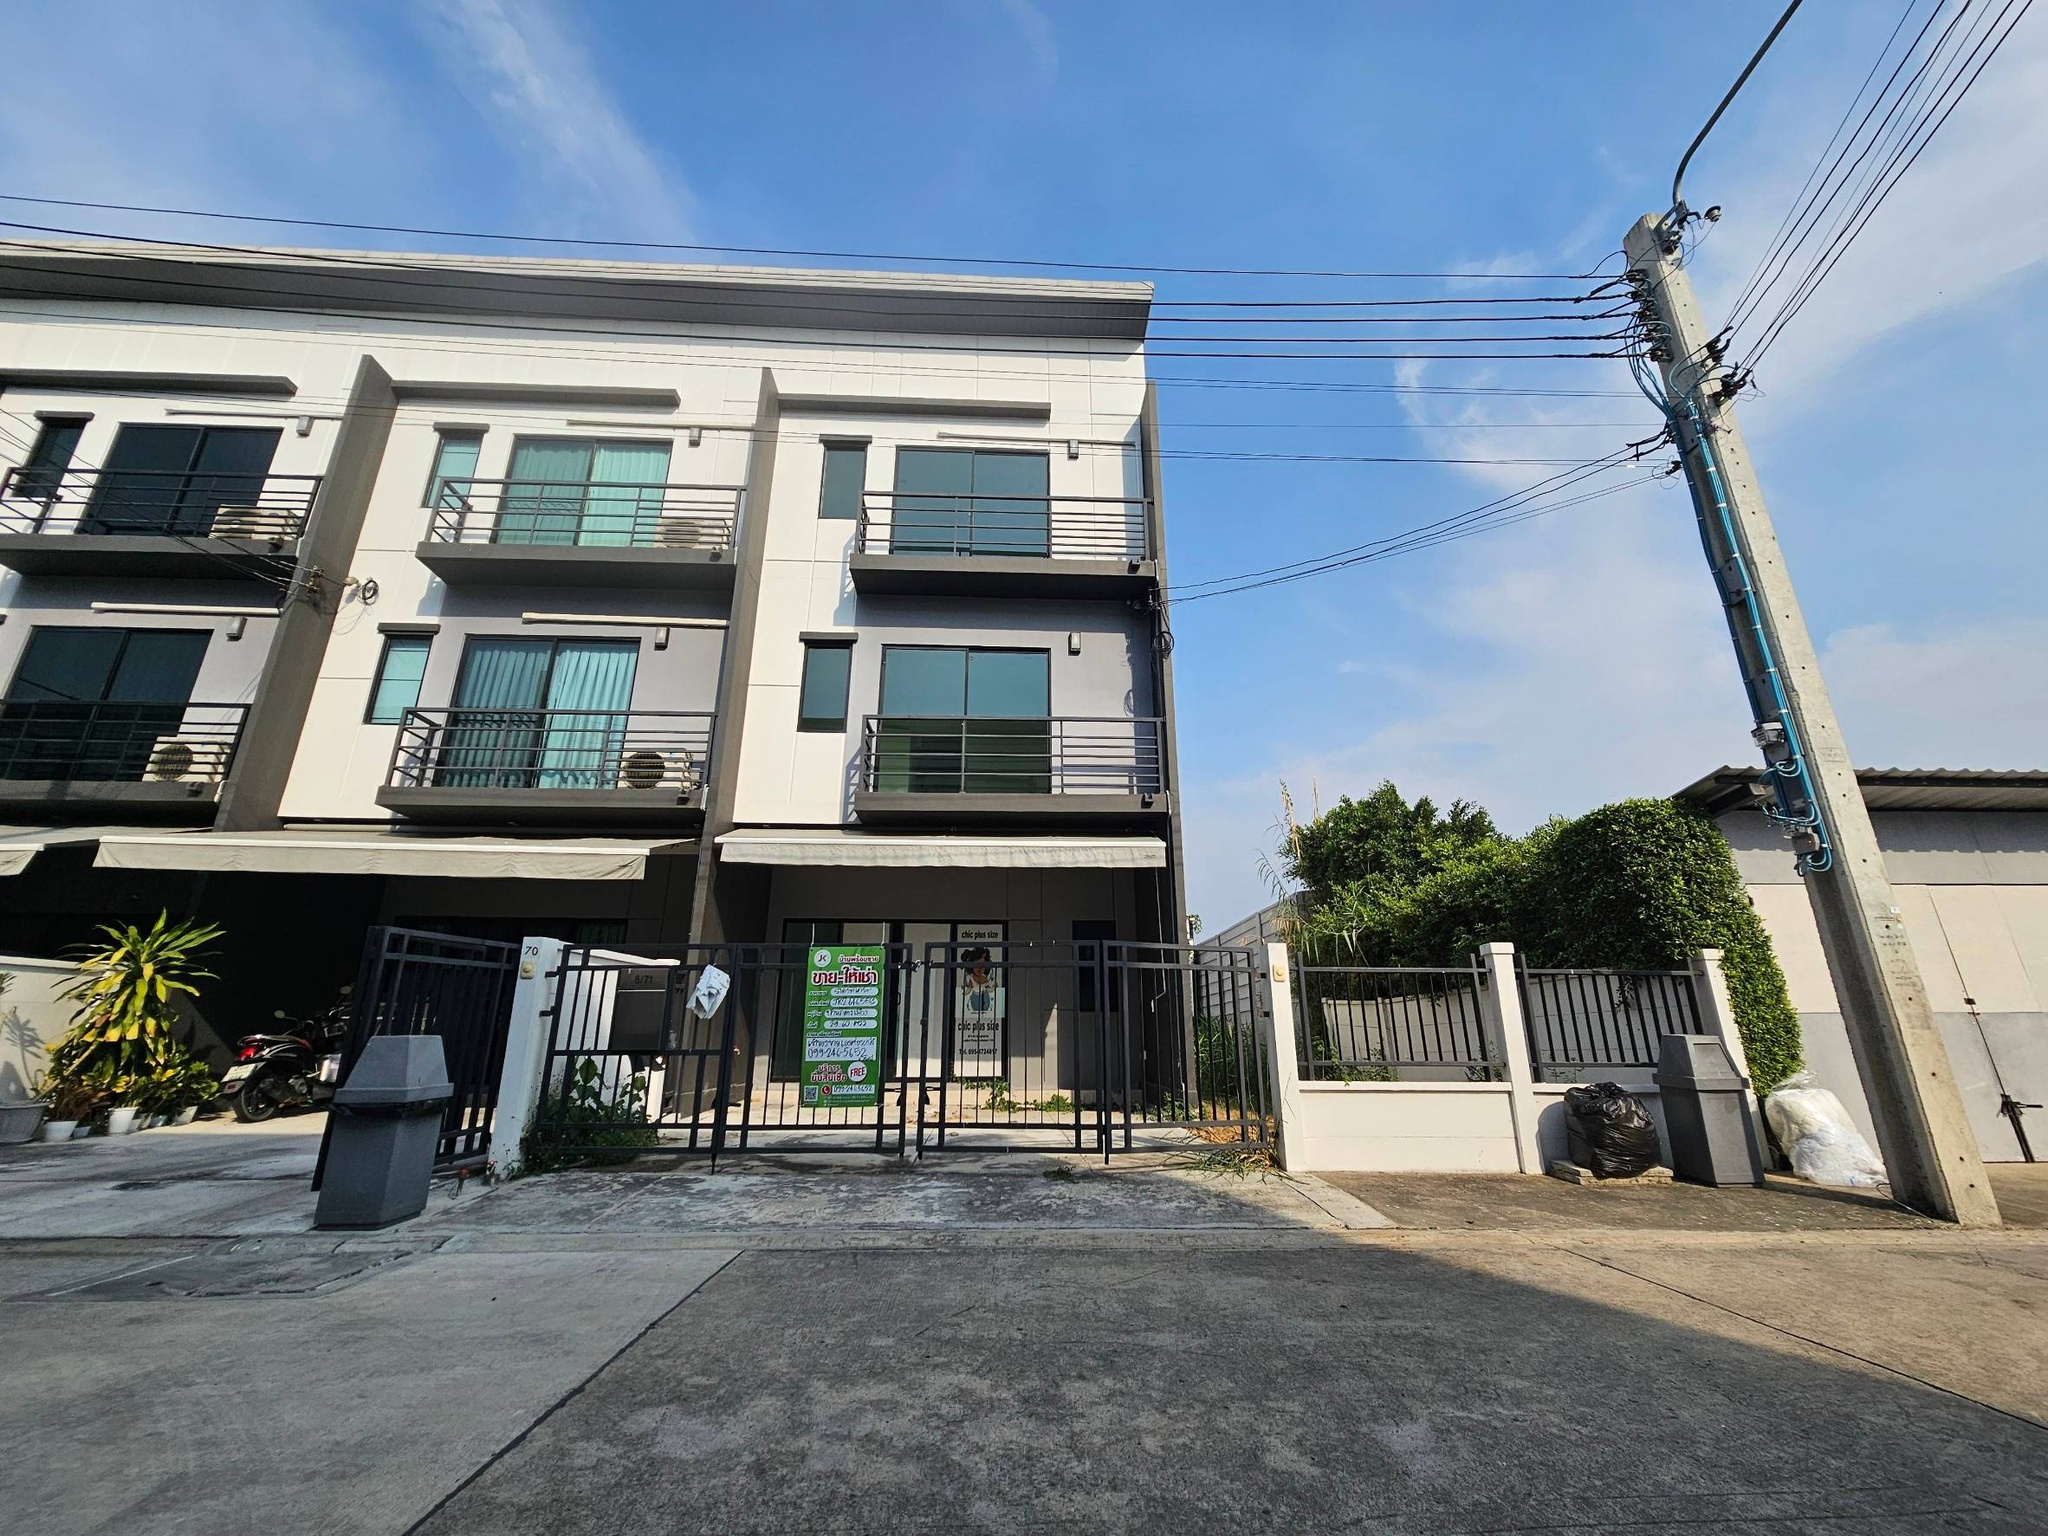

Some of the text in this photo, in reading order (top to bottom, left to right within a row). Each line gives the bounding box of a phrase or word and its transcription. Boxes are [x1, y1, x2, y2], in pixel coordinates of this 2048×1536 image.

[961, 930, 999, 940] chic plus size
[525, 946, 539, 956] 70
[850, 1067, 866, 1077] FREE
